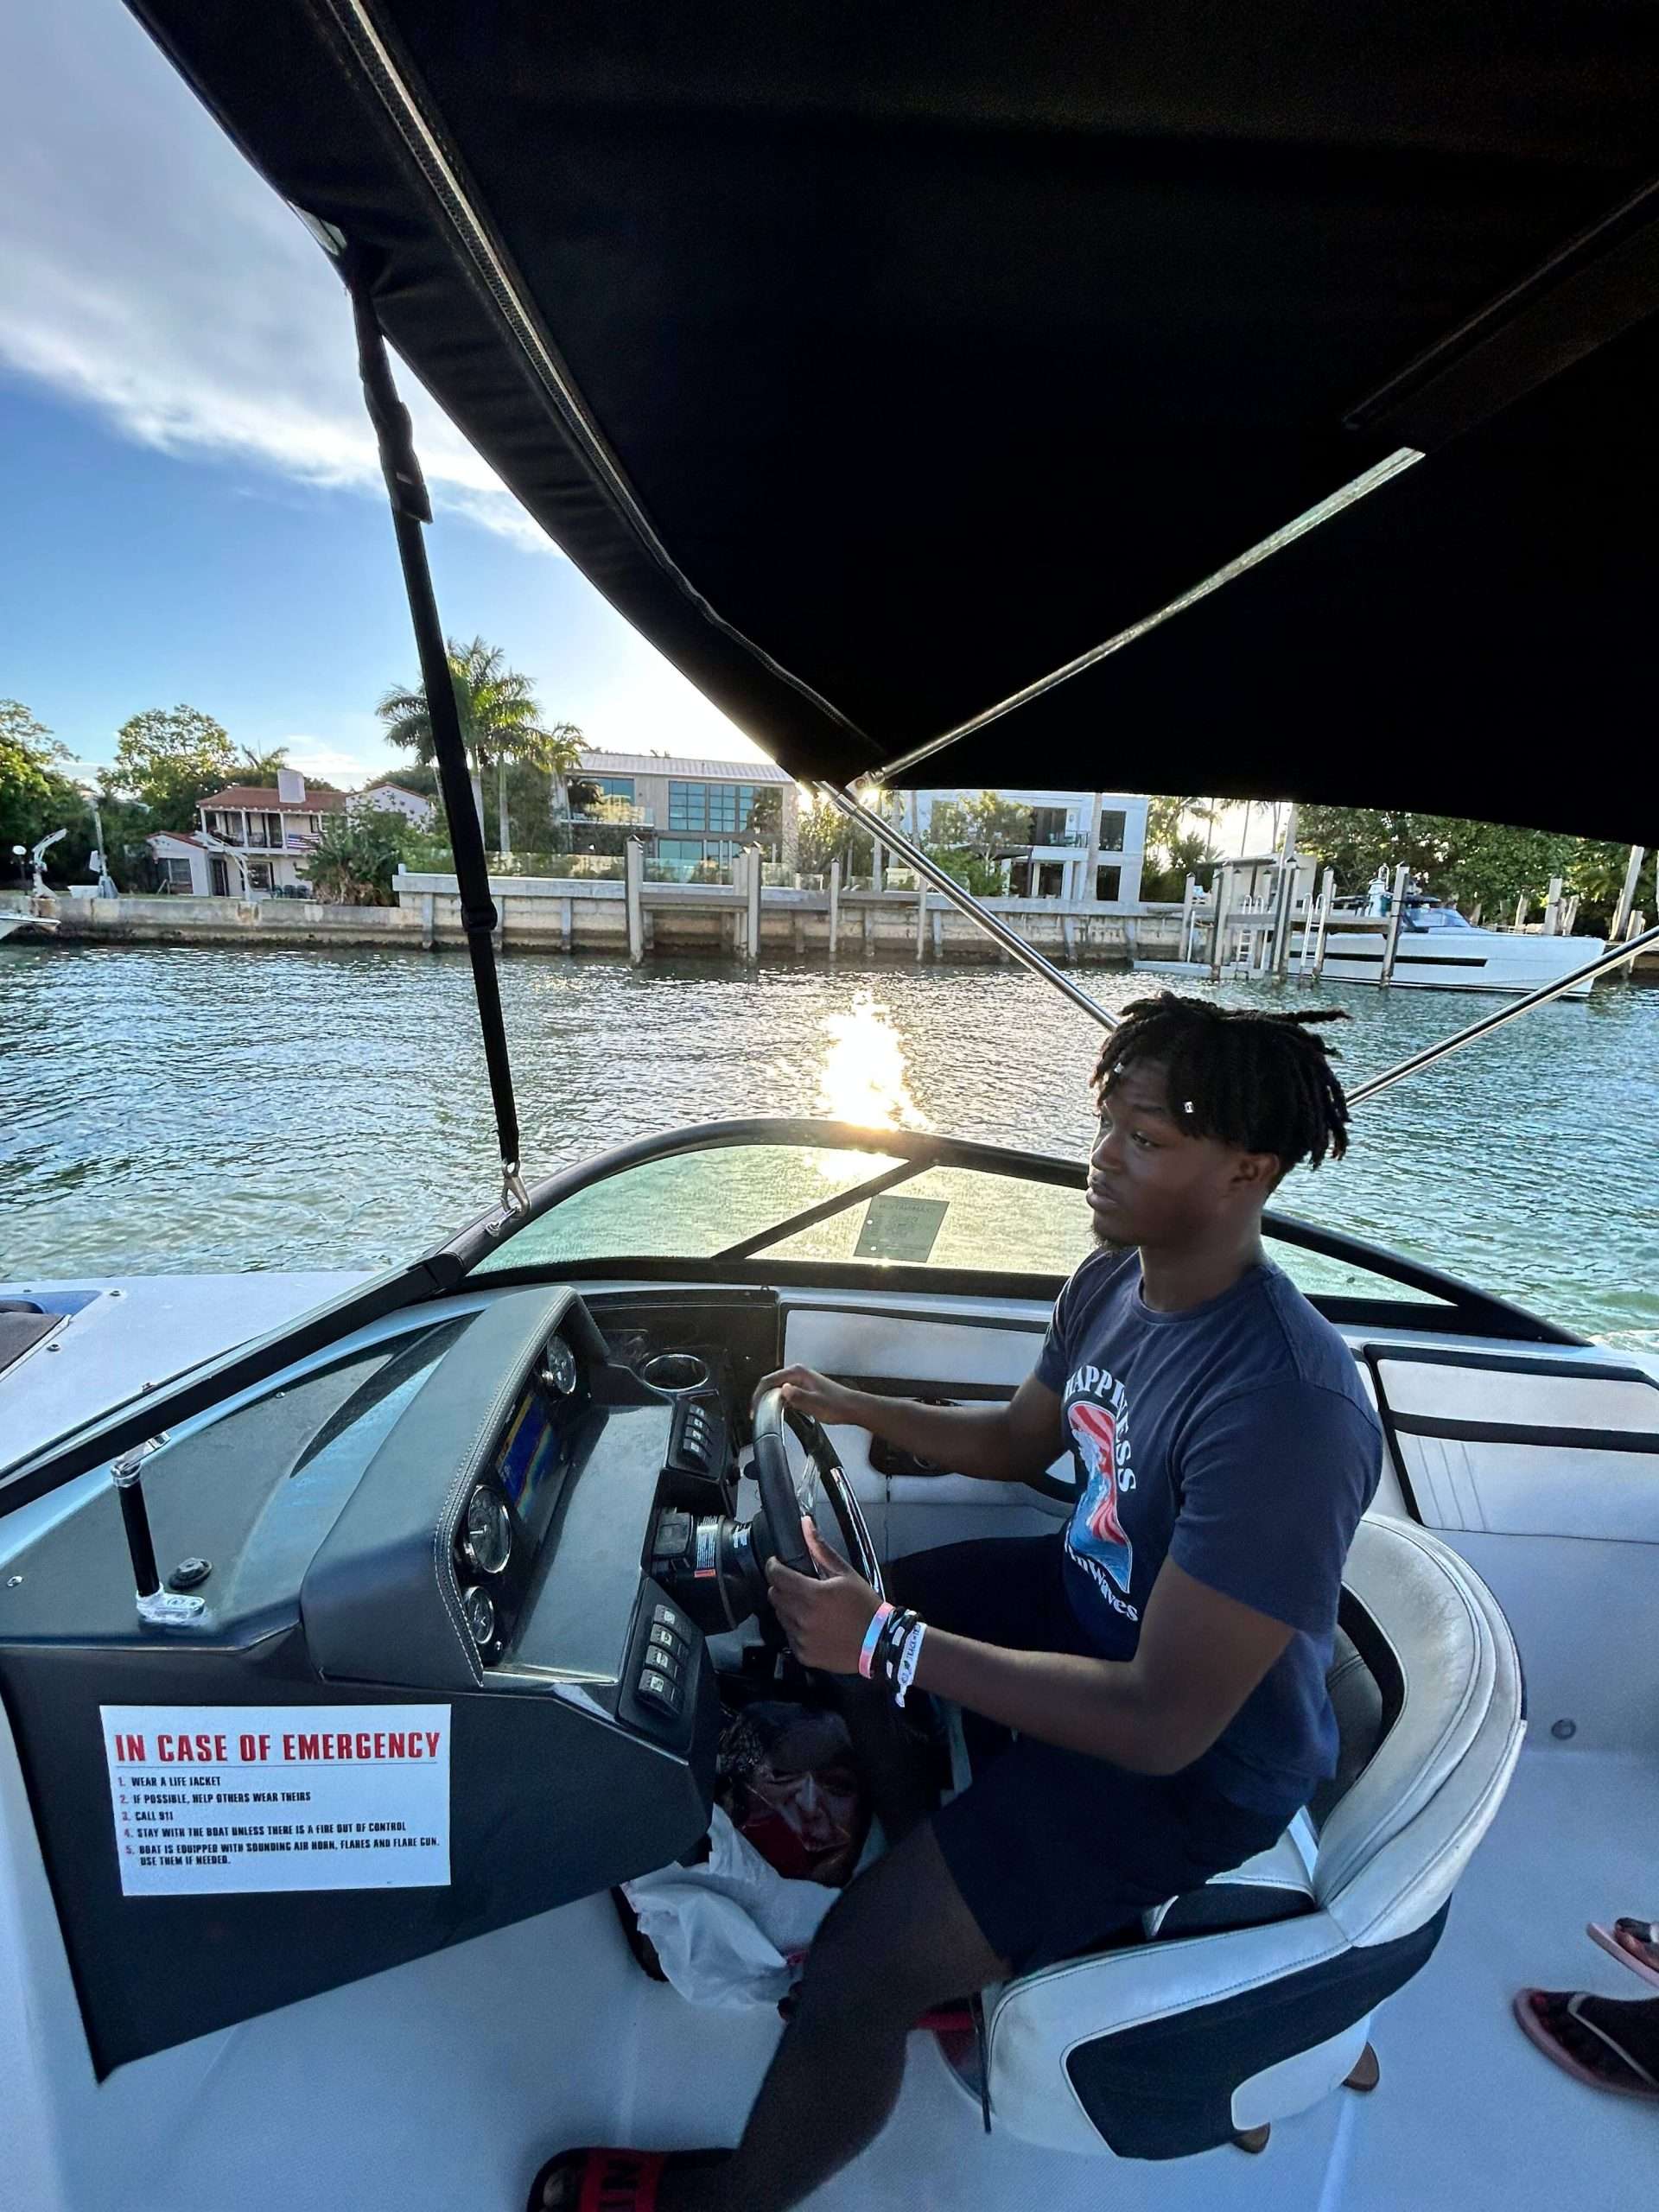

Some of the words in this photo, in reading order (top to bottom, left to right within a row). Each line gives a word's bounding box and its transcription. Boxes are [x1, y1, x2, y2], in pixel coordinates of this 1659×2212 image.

[1064, 1364, 1136, 1492] HAPPINESS
[115, 1734, 145, 1762] IN
[158, 1734, 227, 1762] CASE
[239, 1734, 270, 1761] OF
[283, 1732, 441, 1760] EMERGENCY
[131, 1777, 157, 1786] WEAR
[161, 1777, 166, 1786] A
[169, 1777, 187, 1786] LIFE
[189, 1777, 220, 1786] JACKET
[120, 1795, 129, 1803] 2.
[133, 1794, 140, 1803] IF
[144, 1794, 190, 1804] POSSIBLE,
[192, 1793, 213, 1803] HELP
[216, 1793, 250, 1802] OTHERS
[252, 1792, 278, 1802] WEAR
[281, 1792, 311, 1802] THEIRS
[135, 1811, 156, 1821] CALL
[159, 1811, 174, 1821] 911
[137, 1827, 158, 1838] STAY
[162, 1827, 185, 1838] WITH
[188, 1827, 204, 1837] THE
[206, 1826, 229, 1836] BOAT
[232, 1826, 264, 1836] UNLESS
[267, 1825, 293, 1835] THERE
[296, 1825, 305, 1834] IS
[307, 1825, 314, 1834] A
[316, 1824, 334, 1834] FIRE
[336, 1823, 353, 1834] OUT
[355, 1823, 366, 1833] OF
[368, 1821, 406, 1832] CONTROL
[125, 1846, 135, 1855] 5.
[139, 1845, 161, 1854] BOAT
[164, 1845, 173, 1853] IS
[176, 1844, 218, 1853] EQUIPPED
[220, 1843, 244, 1853] WITH
[245, 1842, 291, 1853] SOUNDING
[294, 1841, 308, 1851] AIR
[311, 1840, 338, 1851] HORN,
[340, 1839, 371, 1849] FLARES
[373, 1838, 391, 1848] AND
[393, 1838, 416, 1847] FLARE
[140, 1857, 156, 1866] USE
[159, 1856, 183, 1866] THEM
[186, 1856, 193, 1865] IF
[196, 1855, 231, 1865] NEEDED.
